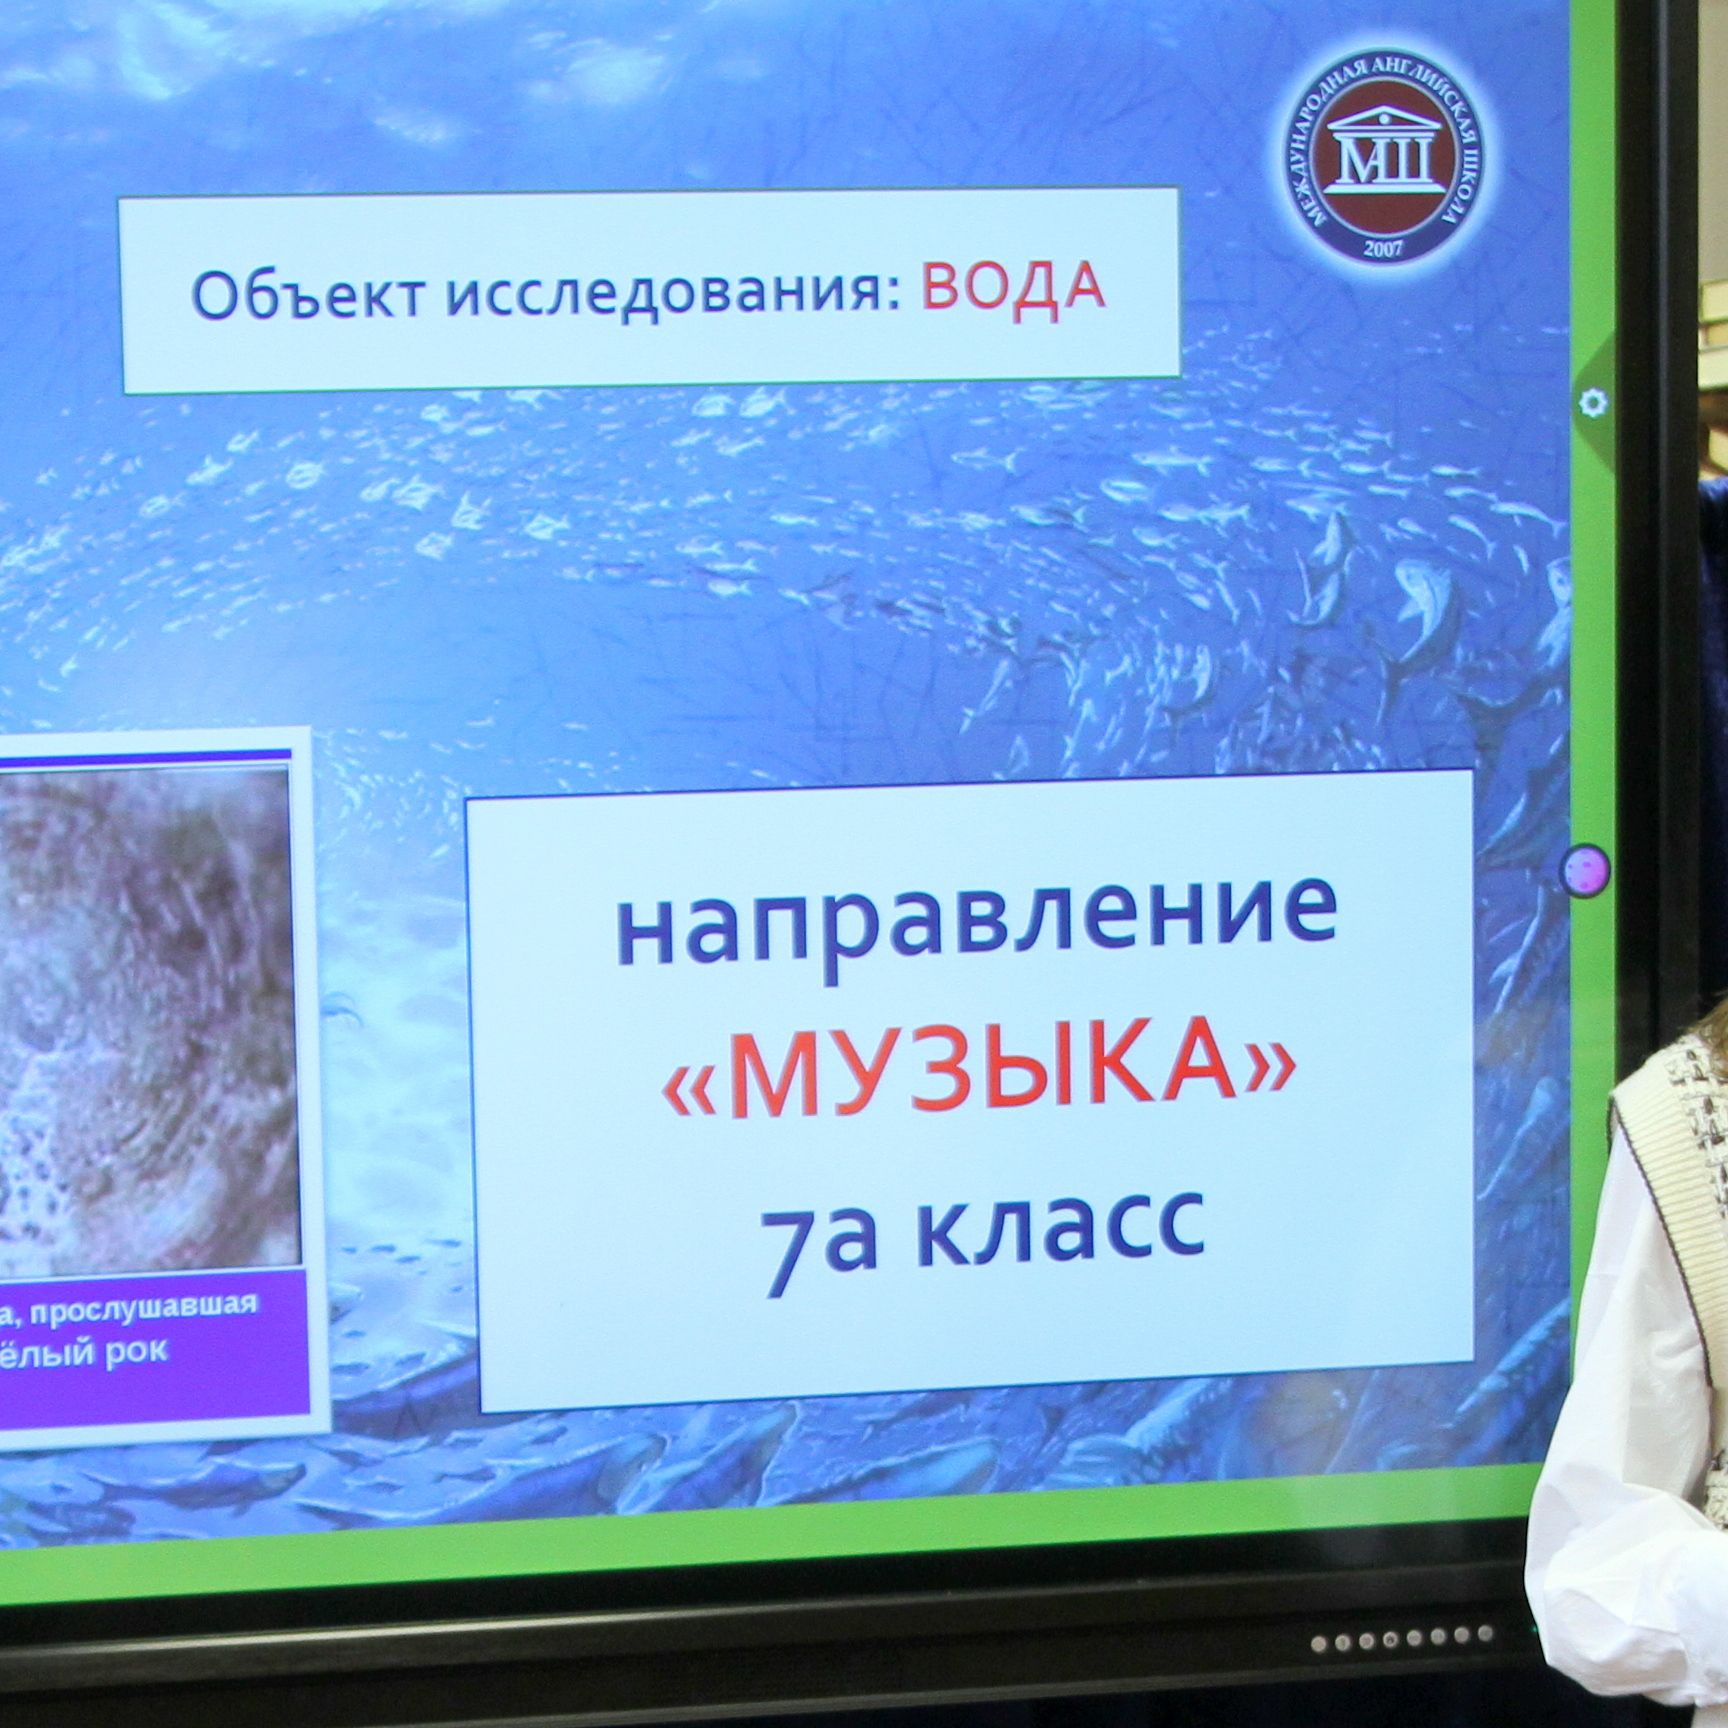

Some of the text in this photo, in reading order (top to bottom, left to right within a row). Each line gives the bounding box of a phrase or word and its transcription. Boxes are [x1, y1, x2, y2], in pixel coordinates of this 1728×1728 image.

[1289, 56, 1480, 228] МЕЖДУНАРОДНАЯ АНГЛИЙСКАЯ ШКОЛА
[190, 258, 1107, 326] Объект исследования: ВОДА
[1363, 240, 1404, 258] 2007
[616, 874, 1339, 988] направление
[661, 1013, 1298, 1121] «МУЗЫКА»
[758, 1189, 1205, 1301] 7а класс
[30, 1293, 258, 1329] прослушавшая
[105, 1338, 169, 1372] рок
